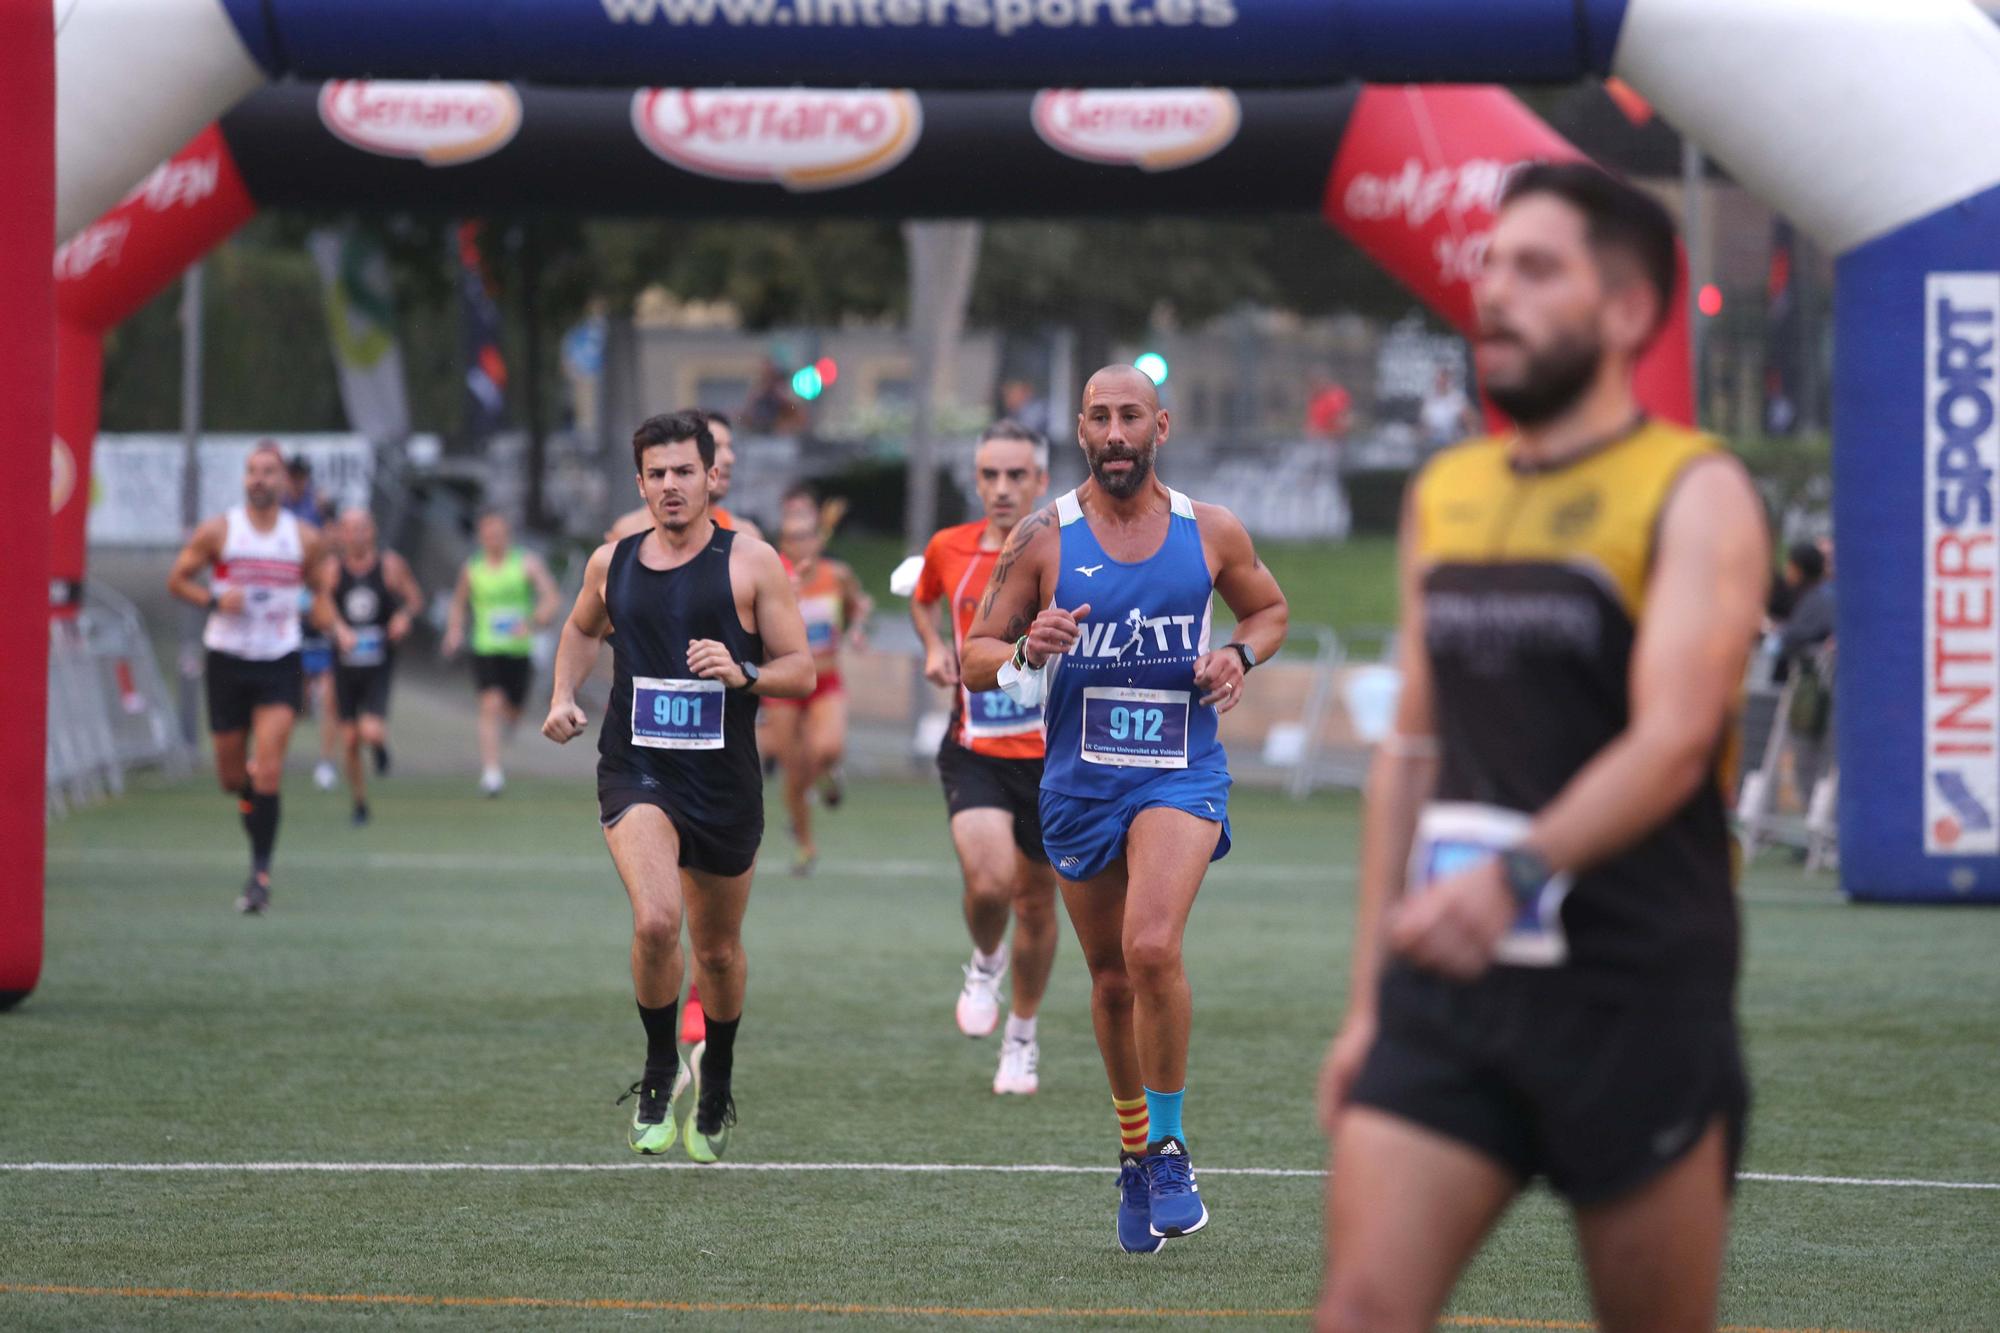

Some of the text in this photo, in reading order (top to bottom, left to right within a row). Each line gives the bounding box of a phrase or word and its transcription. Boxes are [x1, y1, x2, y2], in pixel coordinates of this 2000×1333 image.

[601, 0, 1238, 35] www.intersport.es
[1934, 295, 1994, 757] INTERSPORT
[653, 695, 702, 726] 901
[1109, 706, 1164, 741] 912
[1093, 744, 1116, 752] Carrera
[1118, 745, 1149, 754] Universitat
[1150, 747, 1159, 755] de
